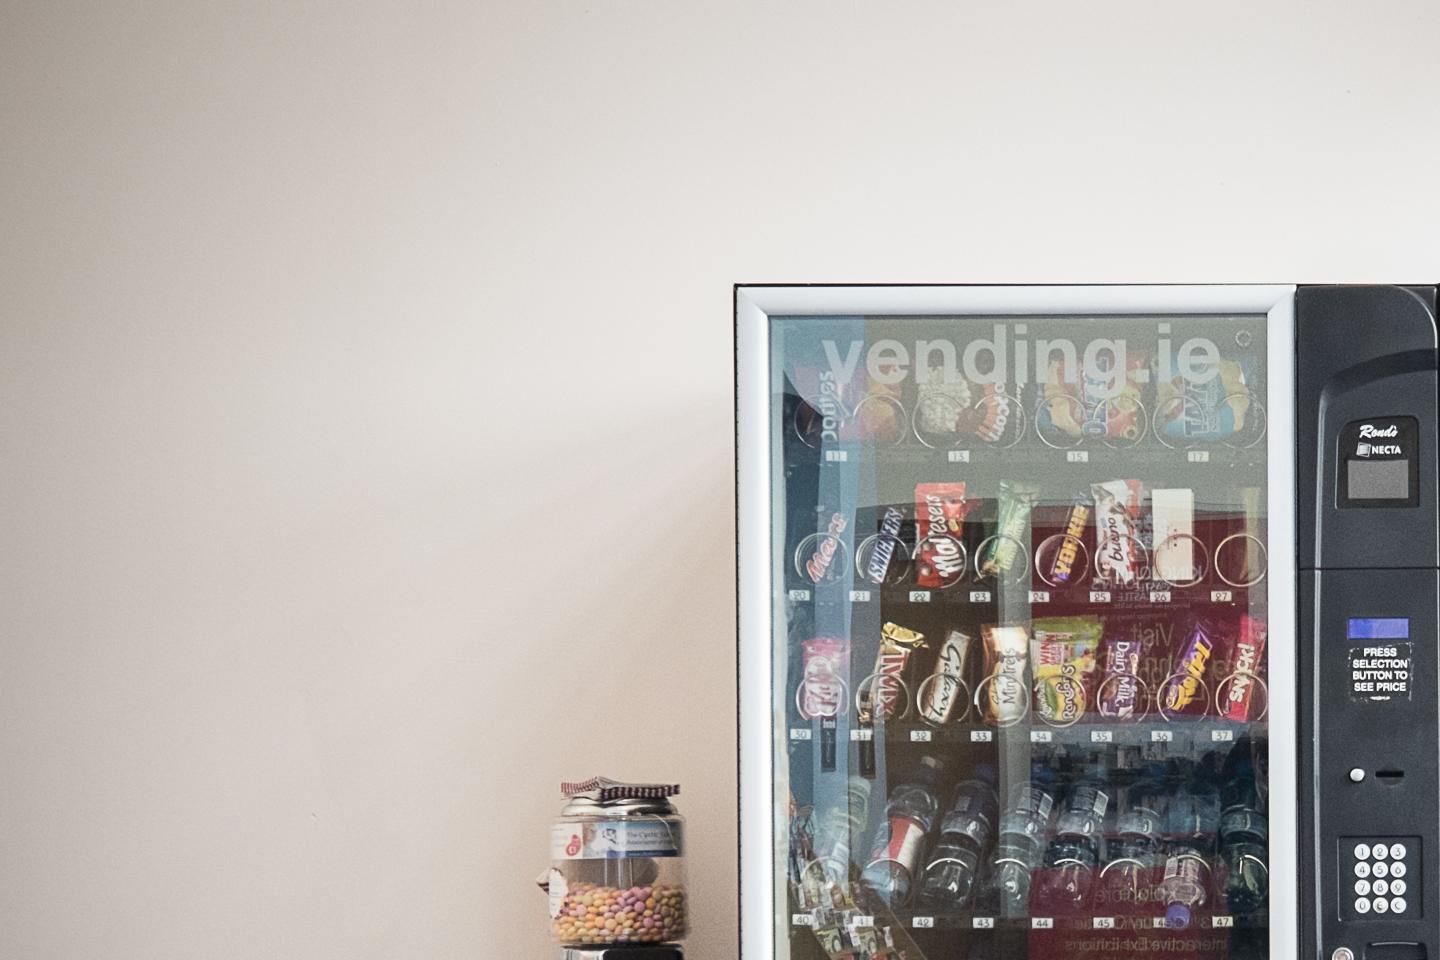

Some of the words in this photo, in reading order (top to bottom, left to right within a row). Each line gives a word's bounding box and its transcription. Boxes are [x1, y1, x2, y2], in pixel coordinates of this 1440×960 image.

[822, 323, 1221, 399] vending.ie
[1371, 445, 1401, 455] NECTA
[1108, 516, 1126, 563] bueno
[1363, 647, 1397, 657] PRESS
[1114, 642, 1130, 673] Dairy
[1352, 659, 1408, 668] SELECTION
[1352, 670, 1393, 680] BUTTON
[1394, 670, 1408, 680] TO
[876, 651, 912, 719] TWIX
[1354, 682, 1374, 692] SEE
[1376, 682, 1407, 692] PRICE
